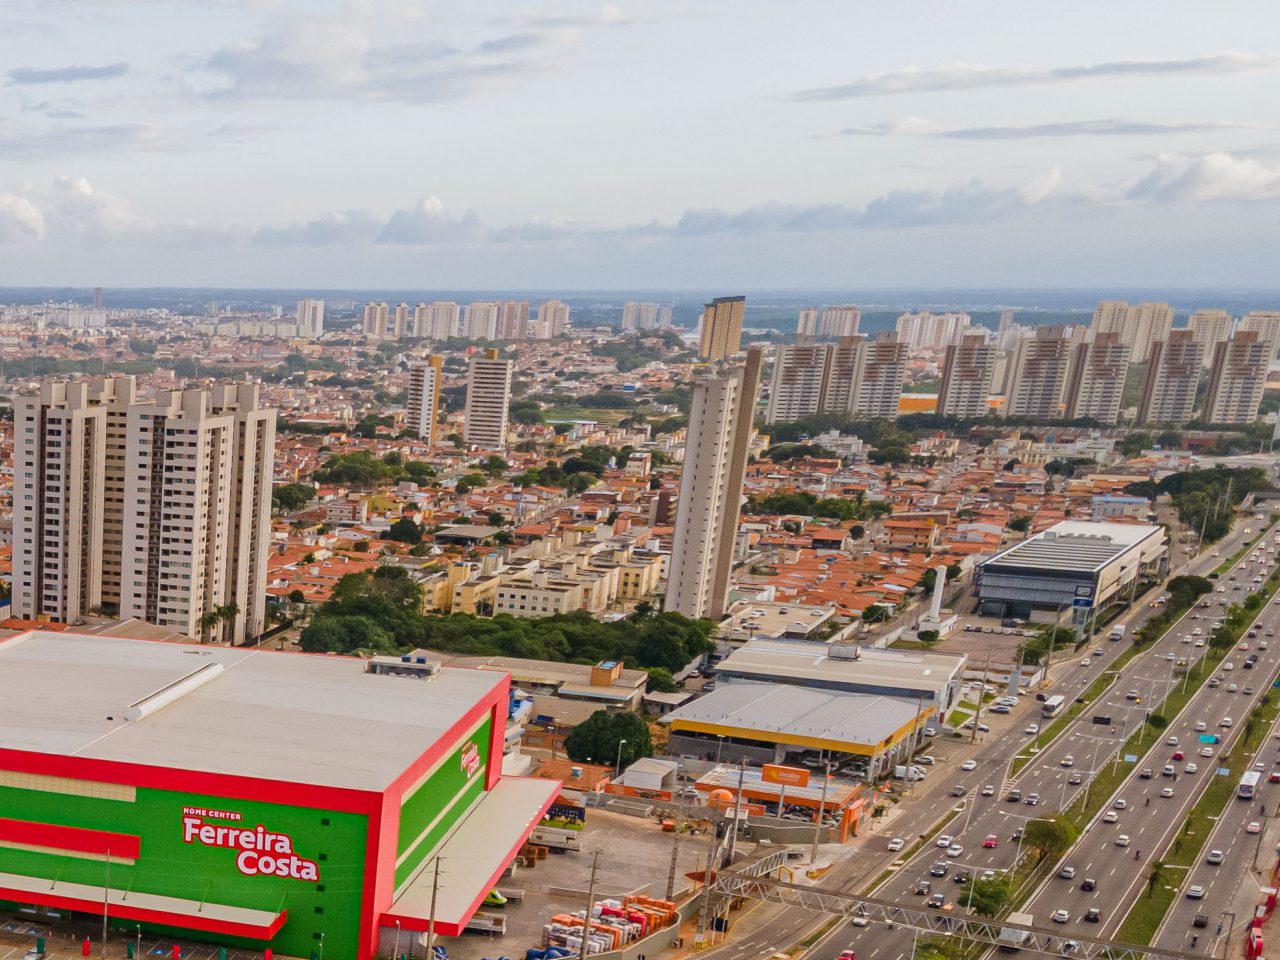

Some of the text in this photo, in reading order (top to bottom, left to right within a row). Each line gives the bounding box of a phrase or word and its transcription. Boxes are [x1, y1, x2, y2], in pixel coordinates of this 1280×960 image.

[183, 807, 241, 820] HOME CENTER
[184, 817, 292, 854] Ferreira
[237, 851, 318, 881] Costa
